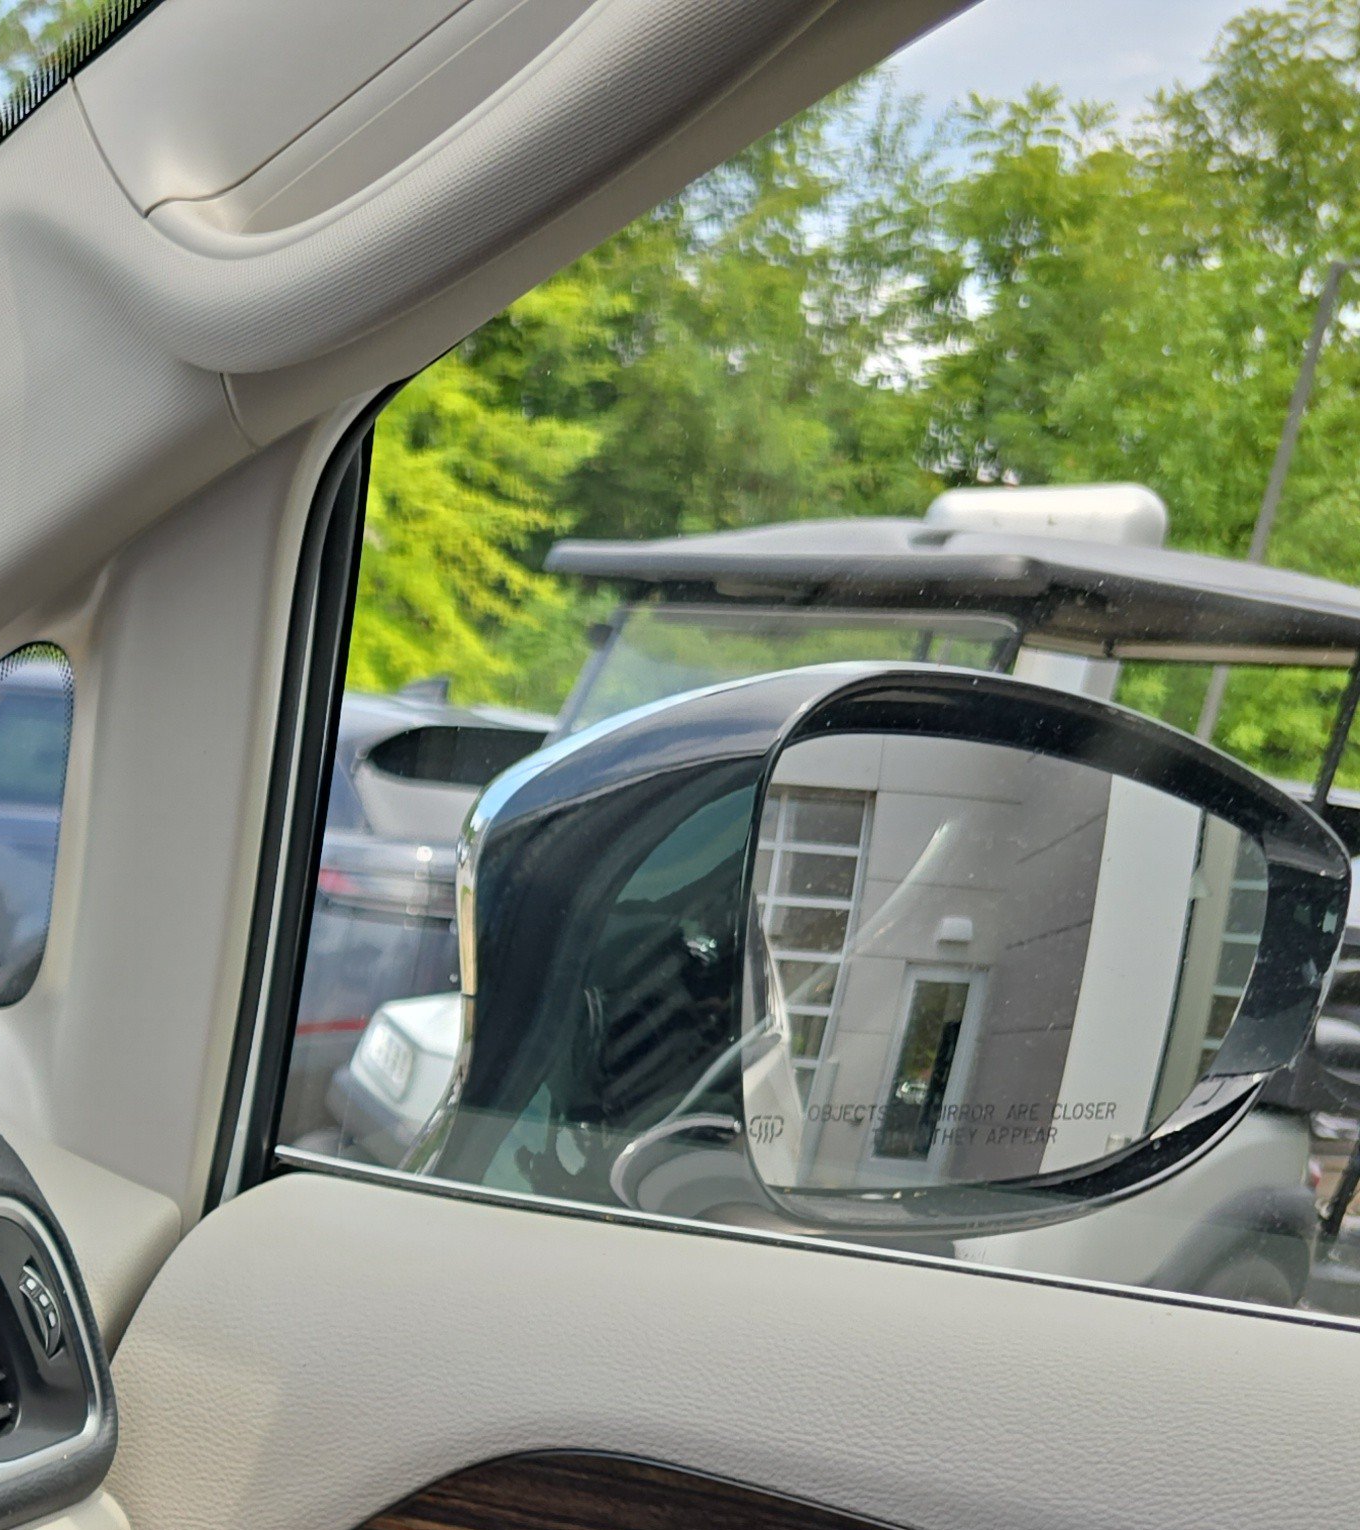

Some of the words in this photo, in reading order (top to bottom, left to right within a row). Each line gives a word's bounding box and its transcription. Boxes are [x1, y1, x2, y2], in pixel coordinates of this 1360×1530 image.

[807, 1103, 886, 1122] OBJECTS
[1005, 1102, 1040, 1120] ARE
[1052, 1101, 1118, 1121] CLOSER
[931, 1127, 978, 1146] THEY
[984, 1126, 1058, 1147] APPEAR
